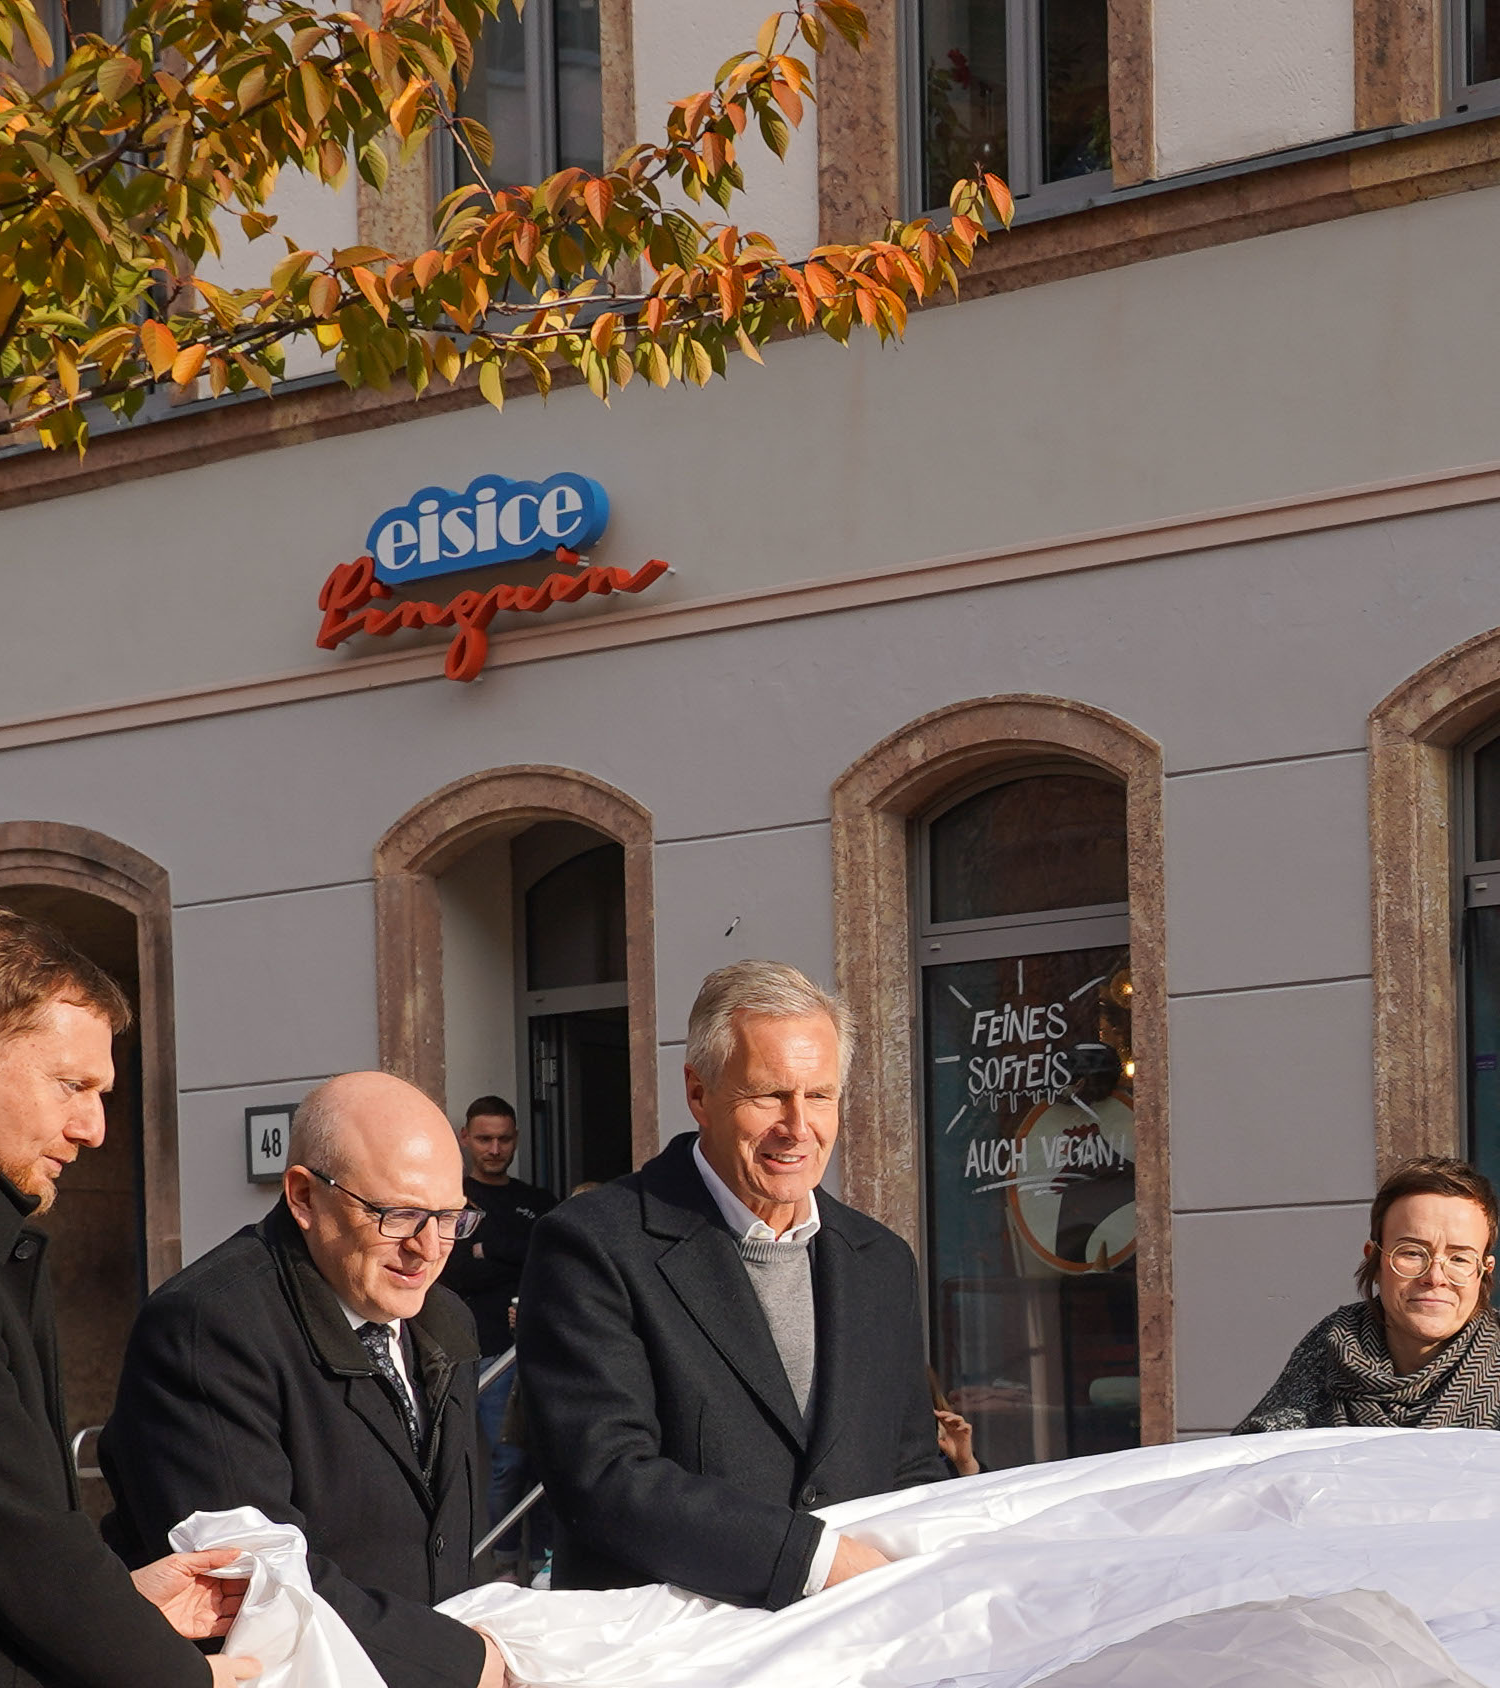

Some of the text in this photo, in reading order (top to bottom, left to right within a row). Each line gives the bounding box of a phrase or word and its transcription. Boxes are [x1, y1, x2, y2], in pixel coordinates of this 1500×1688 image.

[376, 485, 583, 570] eisice
[316, 547, 669, 683] Pinguin
[260, 1127, 283, 1159] 48
[964, 1137, 1028, 1179] AUCH
